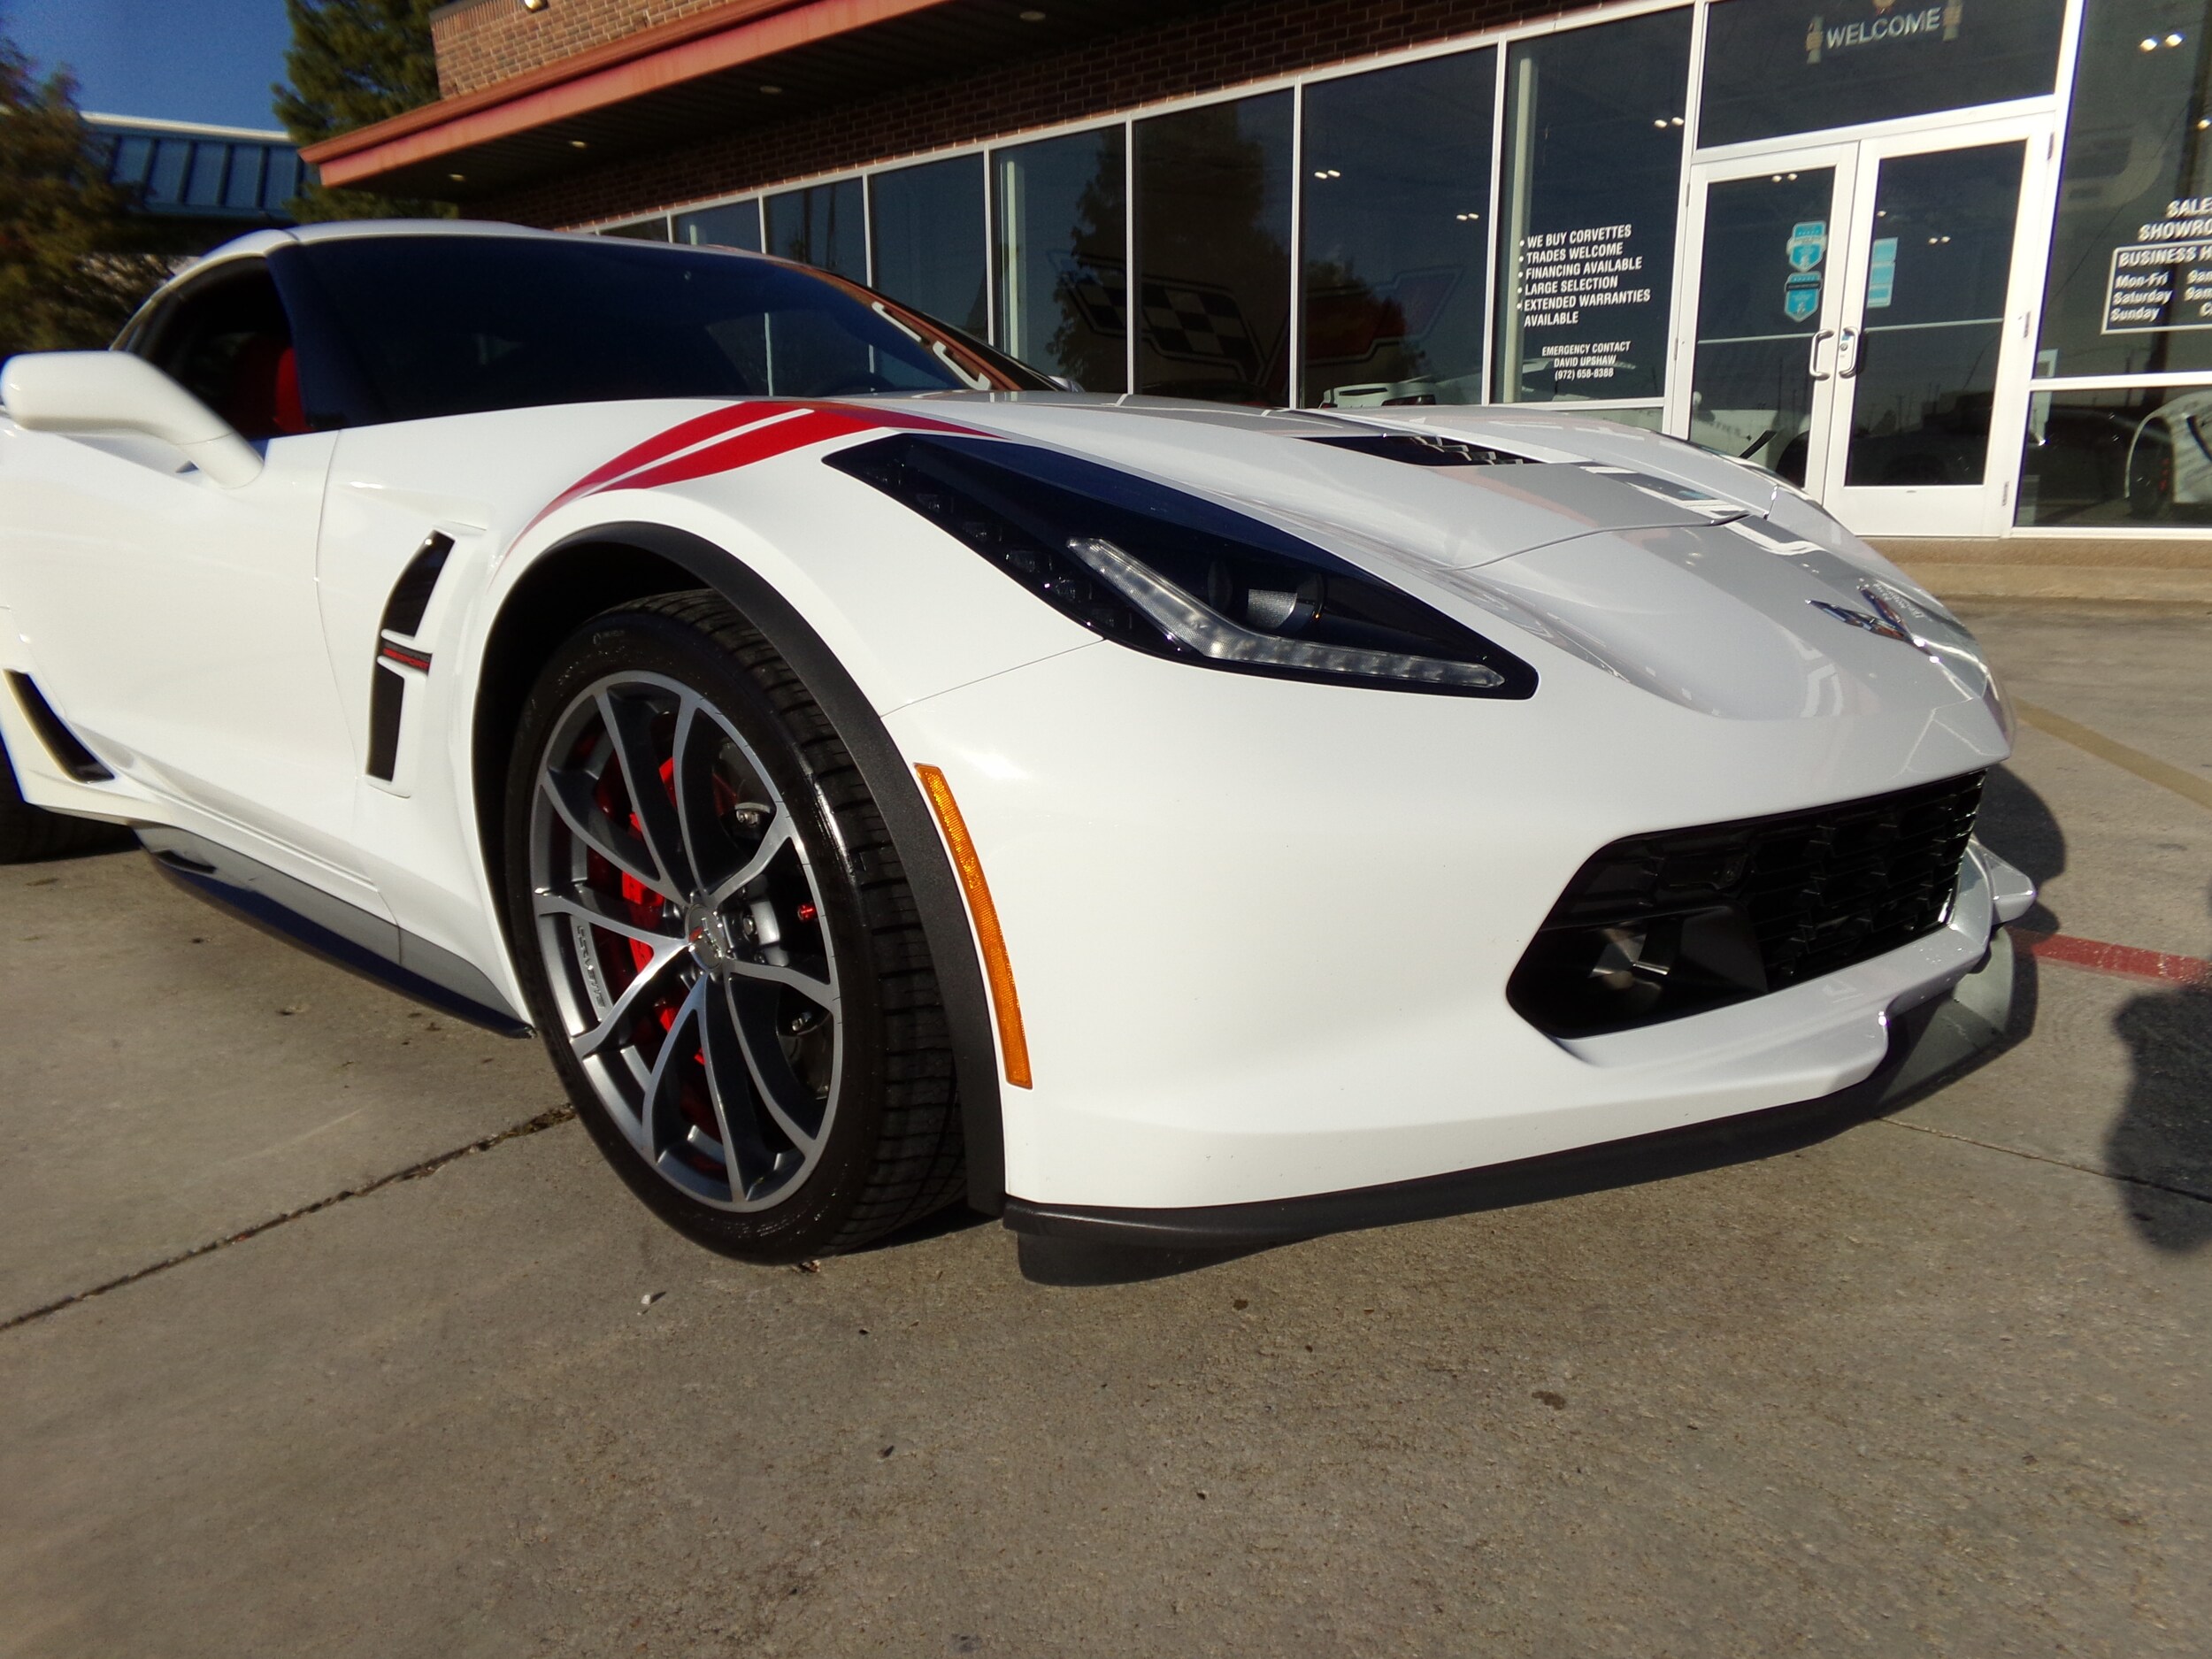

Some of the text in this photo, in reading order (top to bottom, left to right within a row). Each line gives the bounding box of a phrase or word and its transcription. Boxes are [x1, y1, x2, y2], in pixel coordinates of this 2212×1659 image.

[1826, 6, 1941, 50] WELCOME
[1527, 224, 1632, 249] WE BUY CORVETTES
[1526, 242, 1624, 265] TRADES WELCOME
[2118, 246, 2197, 268] BUSINESS
[1525, 257, 1642, 280] FINANCING AVAILABLE
[1525, 275, 1618, 296] LARGE SELECTION
[2115, 271, 2170, 289] Mon-Fri
[1524, 288, 1650, 311] EXTENDED WARRANTIES
[2112, 289, 2173, 305] Saturday
[1524, 311, 1579, 327] AVAILABLE
[2109, 306, 2161, 322] Sunday
[1541, 341, 1631, 357] EMERGENCY CONTACT
[1554, 355, 1617, 368] DAVID UPSHAW
[1555, 367, 1614, 381] (972) 658-8388
